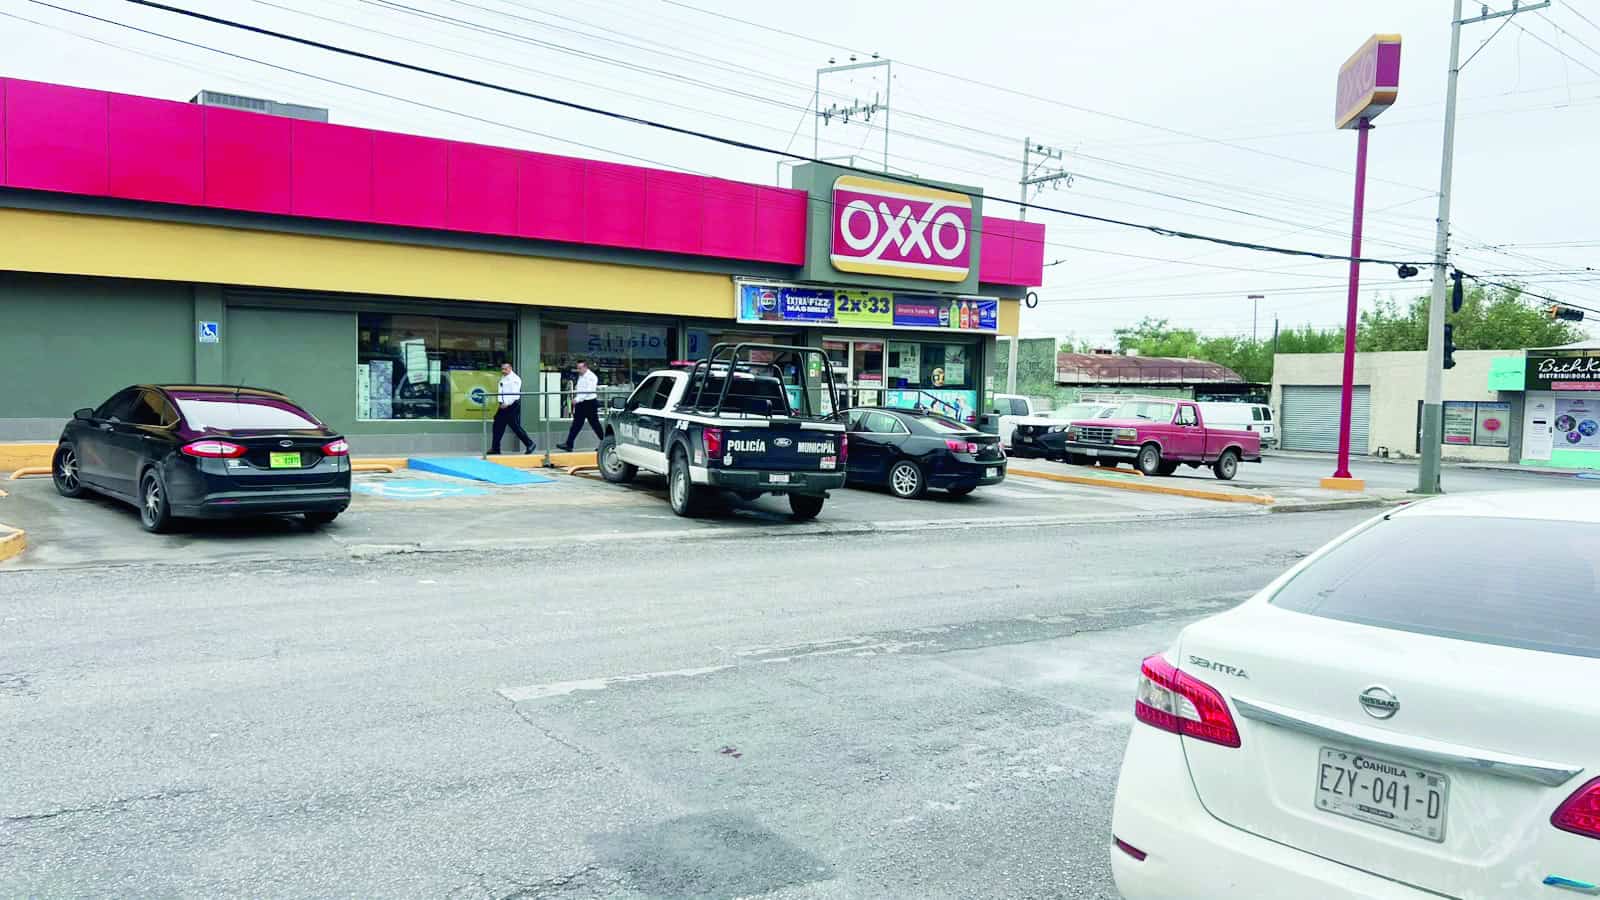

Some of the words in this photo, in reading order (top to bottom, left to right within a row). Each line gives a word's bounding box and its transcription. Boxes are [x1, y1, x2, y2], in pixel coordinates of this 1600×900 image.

[840, 199, 967, 261] OXXO
[1538, 358, 1600, 372] BethK
[727, 438, 766, 453] POLICÍA
[797, 441, 836, 454] MUNICIPAL
[1189, 655, 1250, 680] SENTRA
[1320, 763, 1440, 819] EZY-041-D
